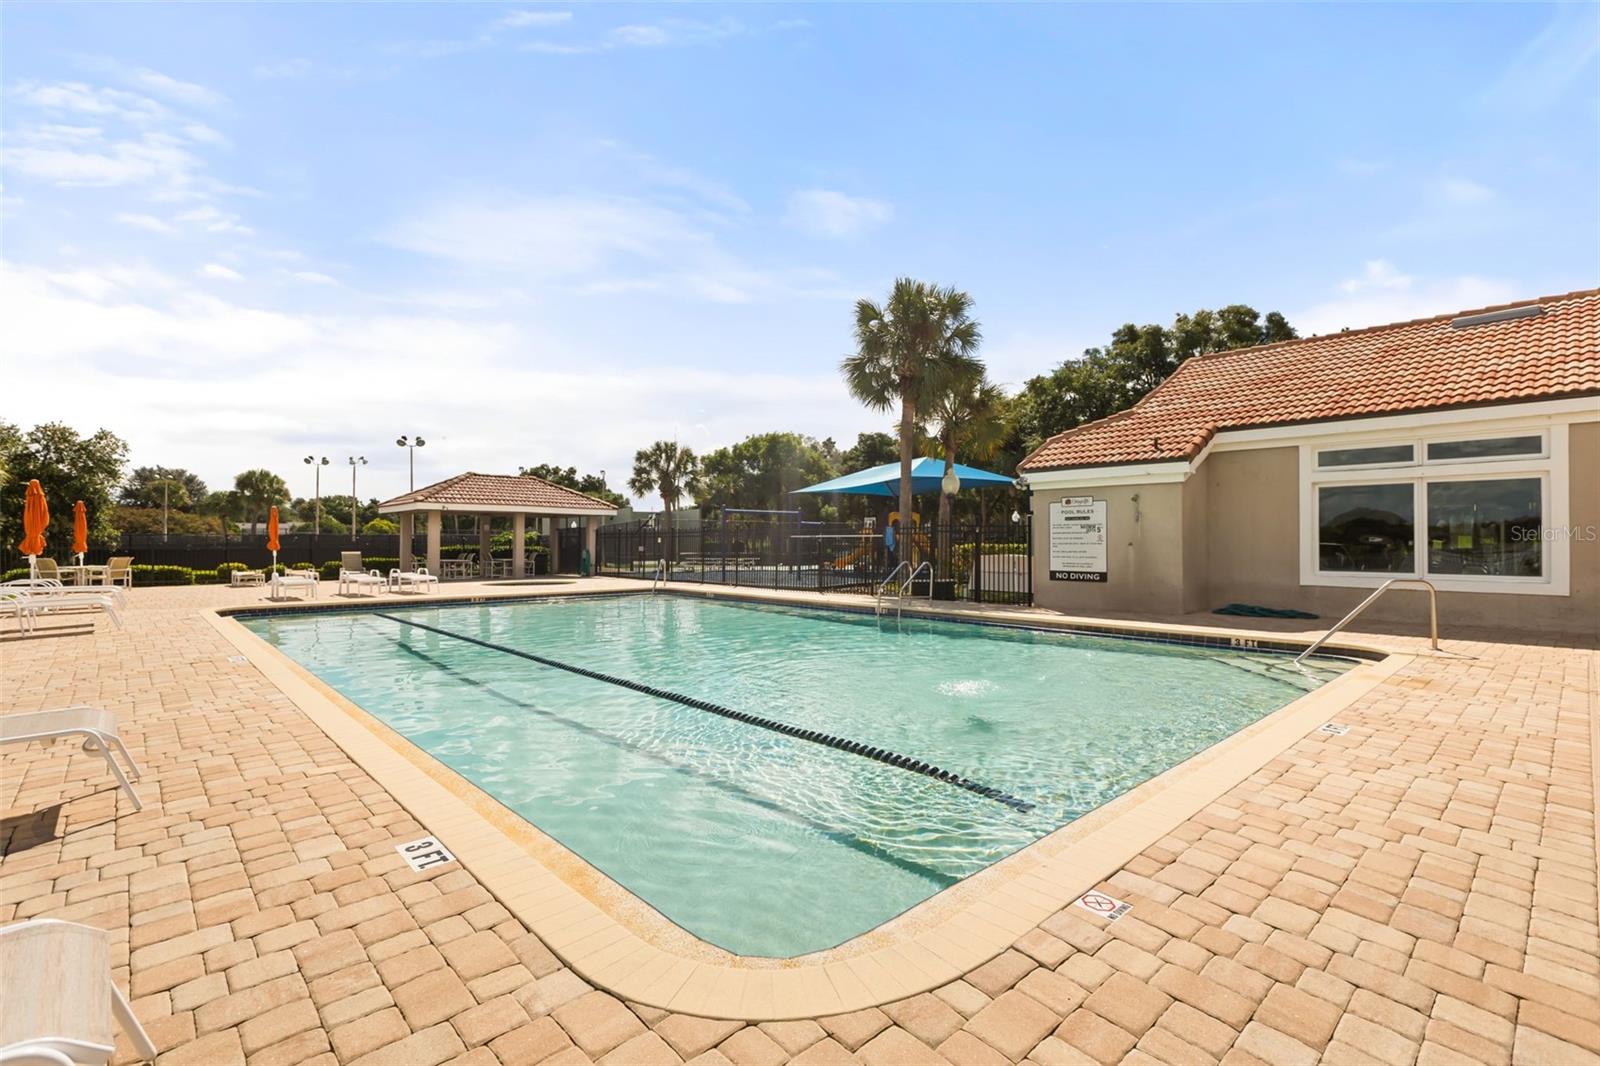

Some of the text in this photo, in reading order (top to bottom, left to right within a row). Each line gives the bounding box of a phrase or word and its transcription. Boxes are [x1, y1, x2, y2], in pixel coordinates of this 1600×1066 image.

[1070, 572, 1100, 580] DIVING
[1234, 638, 1256, 648] 3 FT
[405, 841, 433, 852] 3
